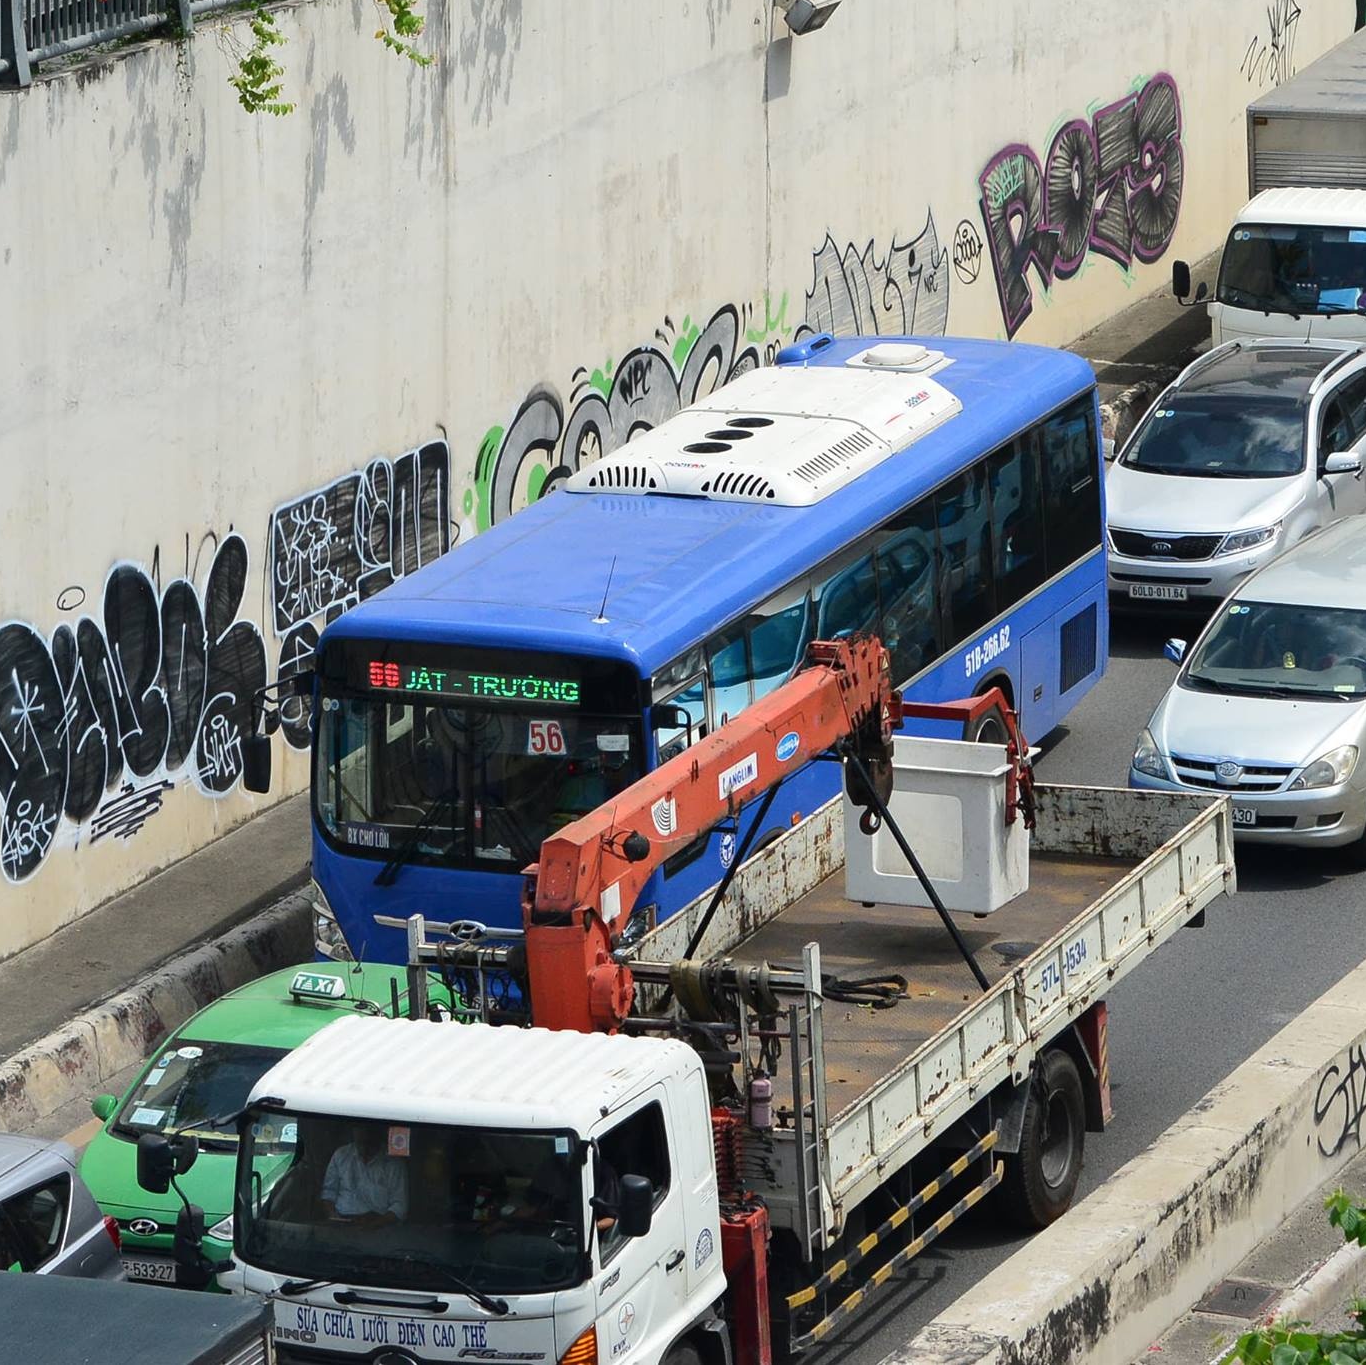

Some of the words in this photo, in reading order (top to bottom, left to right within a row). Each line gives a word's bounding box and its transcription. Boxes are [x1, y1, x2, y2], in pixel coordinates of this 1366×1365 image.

[965, 625, 1010, 678] 51B-266.62
[530, 723, 563, 753] 56
[275, 1326, 317, 1344] INO
[433, 1325, 456, 1348] CAO
